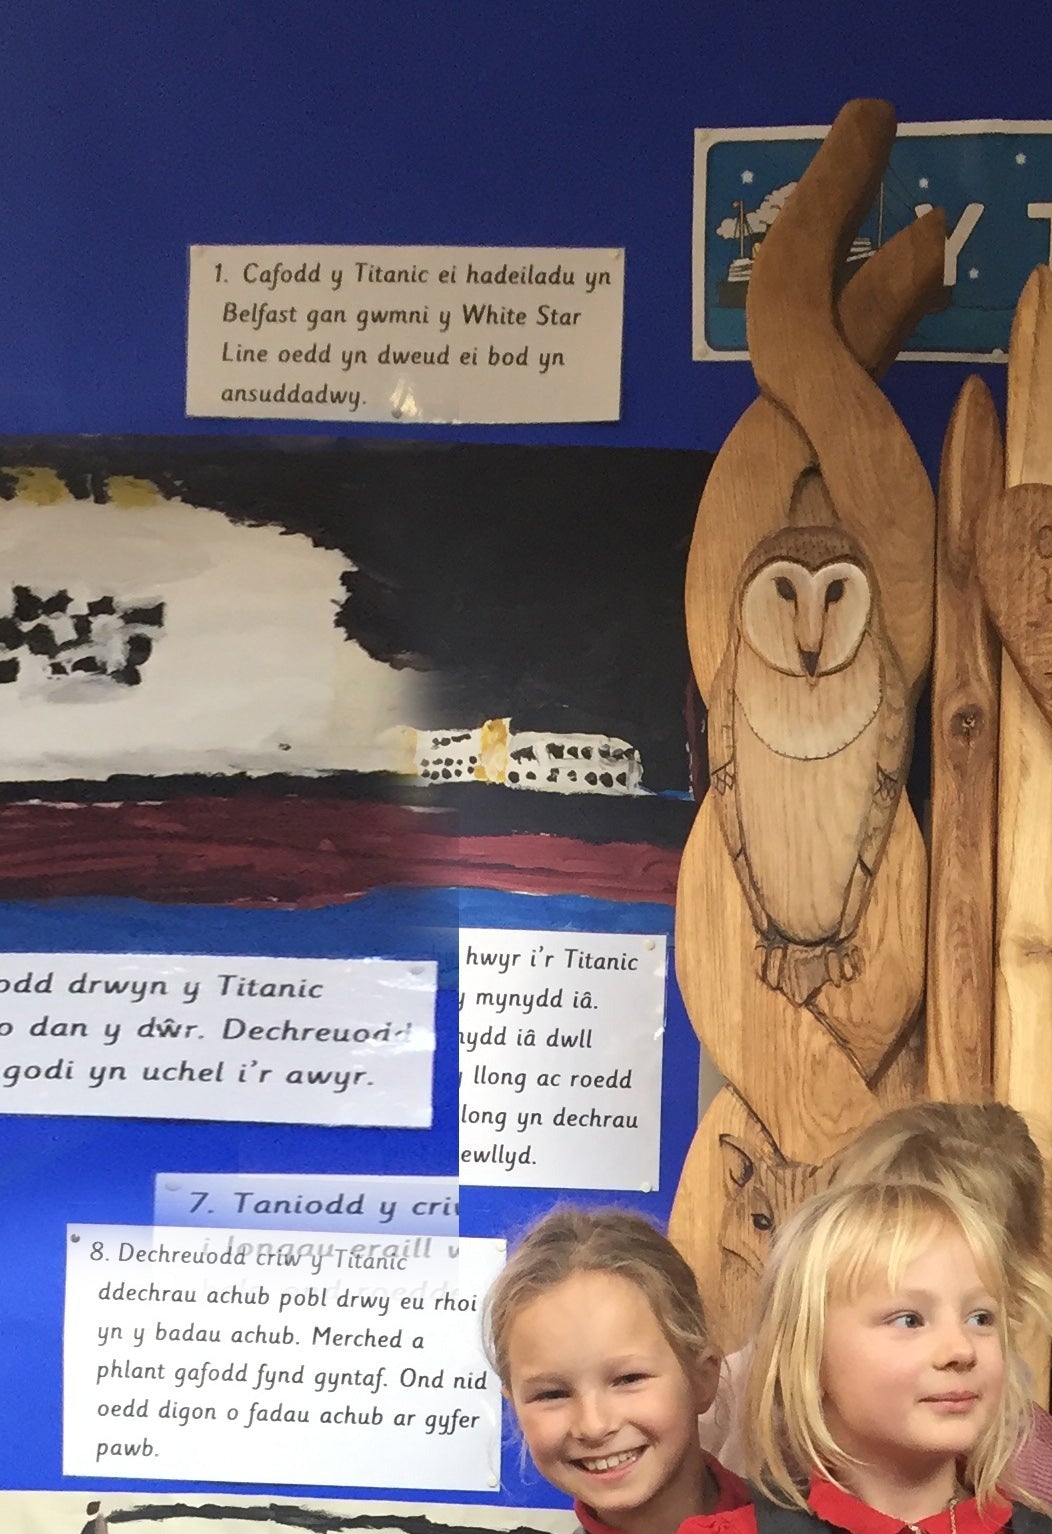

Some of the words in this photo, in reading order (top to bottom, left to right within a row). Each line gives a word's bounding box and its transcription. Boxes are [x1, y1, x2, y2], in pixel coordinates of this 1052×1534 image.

[915, 203, 985, 287] Y
[214, 262, 229, 284] 1.
[243, 261, 321, 292] Cafodd
[330, 269, 343, 292] y
[354, 261, 429, 284] Titanic
[438, 264, 457, 285] ei
[465, 263, 575, 286] hadeiladu
[585, 271, 612, 294] yn
[222, 301, 298, 332] Belfast
[306, 309, 347, 332] gan
[356, 305, 430, 332] gwmni
[439, 310, 451, 333] y
[462, 303, 528, 326] White
[535, 303, 582, 327] Star
[221, 341, 269, 363] Line
[277, 342, 332, 364] oedd
[341, 349, 368, 372] yn
[377, 343, 450, 366] dweud
[459, 346, 478, 366] ei
[487, 344, 529, 368] bod
[538, 351, 566, 375] yn
[220, 382, 367, 413] ansuddadwy.
[465, 945, 522, 975] hwyr
[530, 945, 555, 968] i'r
[564, 947, 639, 971] Titanic
[67, 971, 169, 1004] drwyn
[182, 981, 201, 1005] y
[217, 974, 324, 999] Titanic
[475, 987, 564, 1015] mynydd
[572, 990, 599, 1010] iâ.
[0, 1021, 14, 1037] o
[28, 1015, 89, 1038] dan
[103, 1023, 122, 1047] y
[136, 1016, 205, 1040] dŵr.
[516, 1028, 536, 1047] iâ
[545, 1027, 593, 1049] dwll
[2, 1057, 75, 1089] godi
[88, 1065, 127, 1089] yn
[142, 1059, 225, 1083] uchel
[237, 1059, 273, 1084] i'r
[285, 1069, 374, 1094] awyr.
[473, 1064, 527, 1094] llong
[536, 1073, 562, 1087] ac
[570, 1068, 633, 1089] roedd
[516, 1112, 544, 1133] yn
[552, 1106, 639, 1129] dechrau
[460, 1143, 537, 1172] ewllyd.
[189, 1191, 215, 1215] 7.
[233, 1191, 365, 1216] Taniodd
[378, 1201, 398, 1225] y
[89, 1241, 110, 1262] 8.
[118, 1242, 246, 1266] Dechreuodd
[256, 1247, 301, 1268] criw
[310, 1251, 323, 1275] y
[335, 1249, 408, 1272] Titanic
[98, 1281, 197, 1303] ddechrau
[206, 1284, 270, 1305] achub
[278, 1286, 327, 1314] pobl
[336, 1288, 390, 1317] drwy
[400, 1296, 425, 1311] eu
[434, 1291, 477, 1312] rhoi
[97, 1326, 123, 1347] yn
[133, 1327, 145, 1348] y
[155, 1321, 221, 1343] badau
[230, 1324, 300, 1346] achub.
[311, 1326, 403, 1349] Merched
[412, 1336, 425, 1350] a
[96, 1358, 166, 1386] phlant
[174, 1361, 248, 1389] gafodd
[251, 1362, 305, 1391] fynd
[314, 1366, 388, 1395] gyntaf.
[399, 1367, 445, 1389] Ond
[453, 1370, 488, 1391] nid
[97, 1398, 149, 1418] oedd
[158, 1399, 217, 1427] digon
[226, 1407, 239, 1421] o
[243, 1401, 310, 1429] fadau
[319, 1404, 384, 1426] achub
[393, 1413, 417, 1427] ar
[424, 1408, 481, 1436] gyfer
[95, 1437, 159, 1463] pawb.
